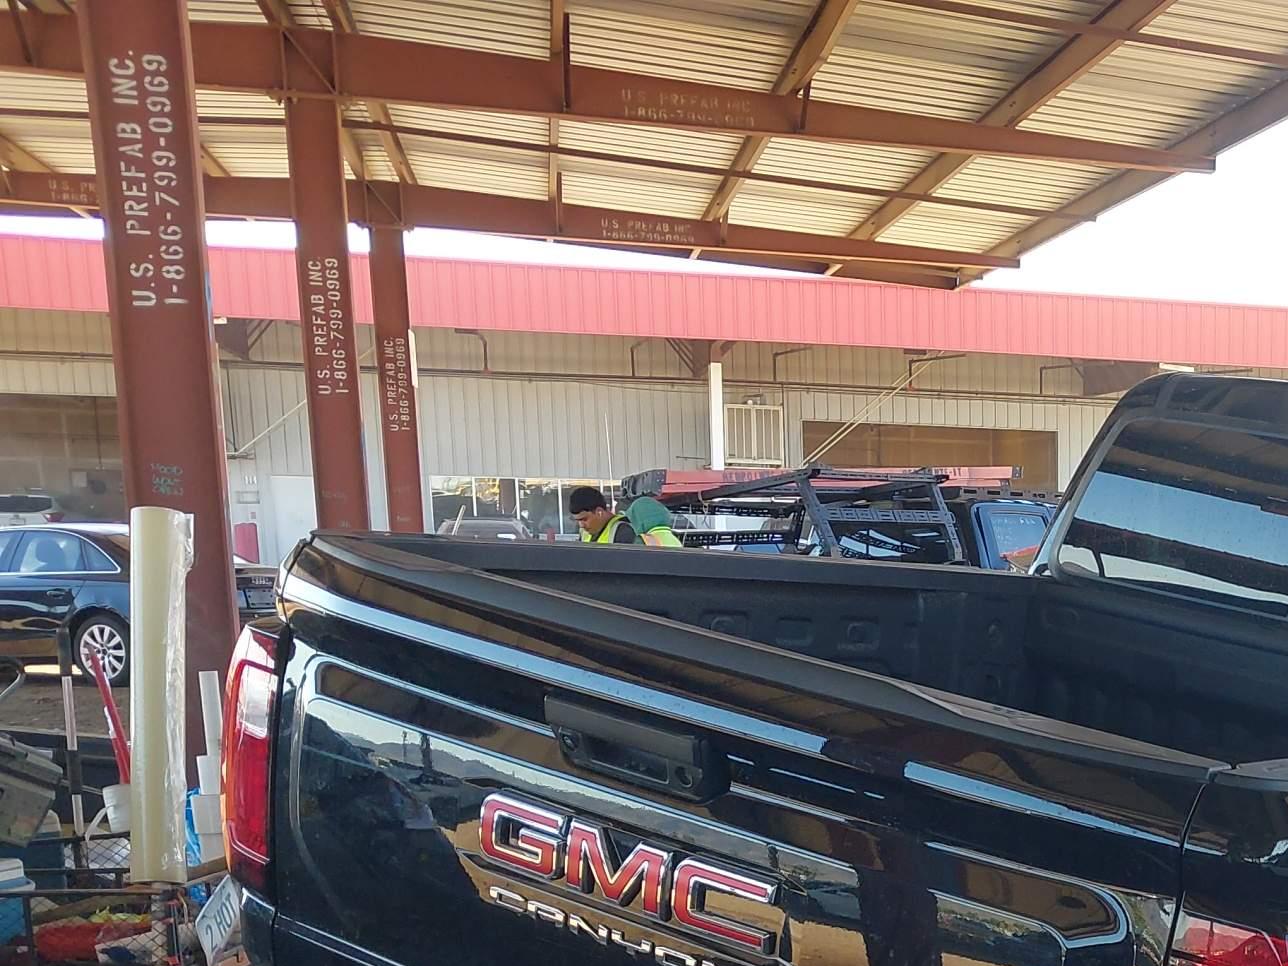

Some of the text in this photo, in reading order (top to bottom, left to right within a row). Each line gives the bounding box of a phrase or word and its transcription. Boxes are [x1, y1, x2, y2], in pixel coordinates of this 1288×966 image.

[108, 50, 157, 307] U.S. PREFAB INC.
[141, 53, 189, 304] 1-866-799-0969
[310, 294, 329, 356] PREFAB
[325, 257, 349, 394] 1-866-799-0969
[385, 362, 398, 405] PREFAB
[395, 337, 411, 431] 1-866-799-0969
[214, 892, 237, 939] HOT
[479, 792, 782, 958] GMC
